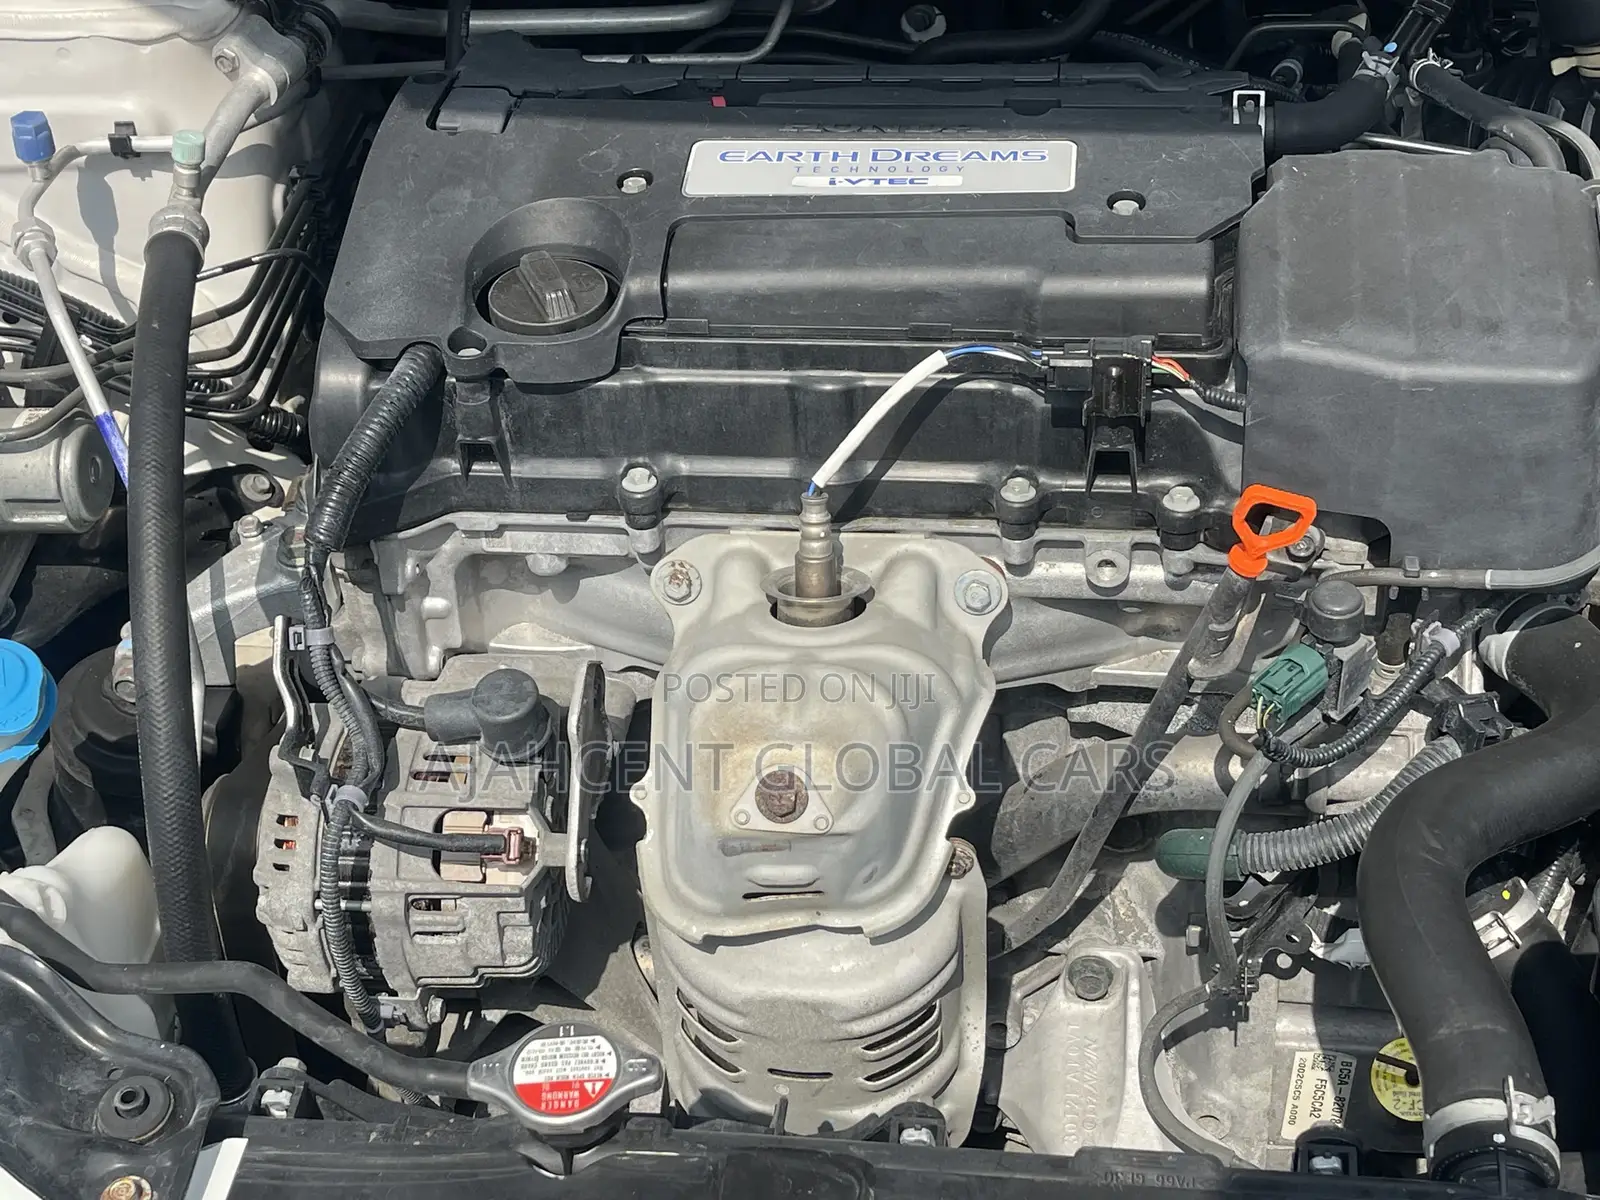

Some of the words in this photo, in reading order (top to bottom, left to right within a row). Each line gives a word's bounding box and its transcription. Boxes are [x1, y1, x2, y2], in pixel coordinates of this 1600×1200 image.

[718, 149, 858, 163] EARTH
[870, 147, 1049, 163] DREAMS
[794, 165, 965, 174] TECHNOLOGY
[828, 176, 929, 186] i-VTEC
[1309, 1078, 1328, 1119] F5C5CA2
[1392, 1098, 1424, 1111] CF-2
